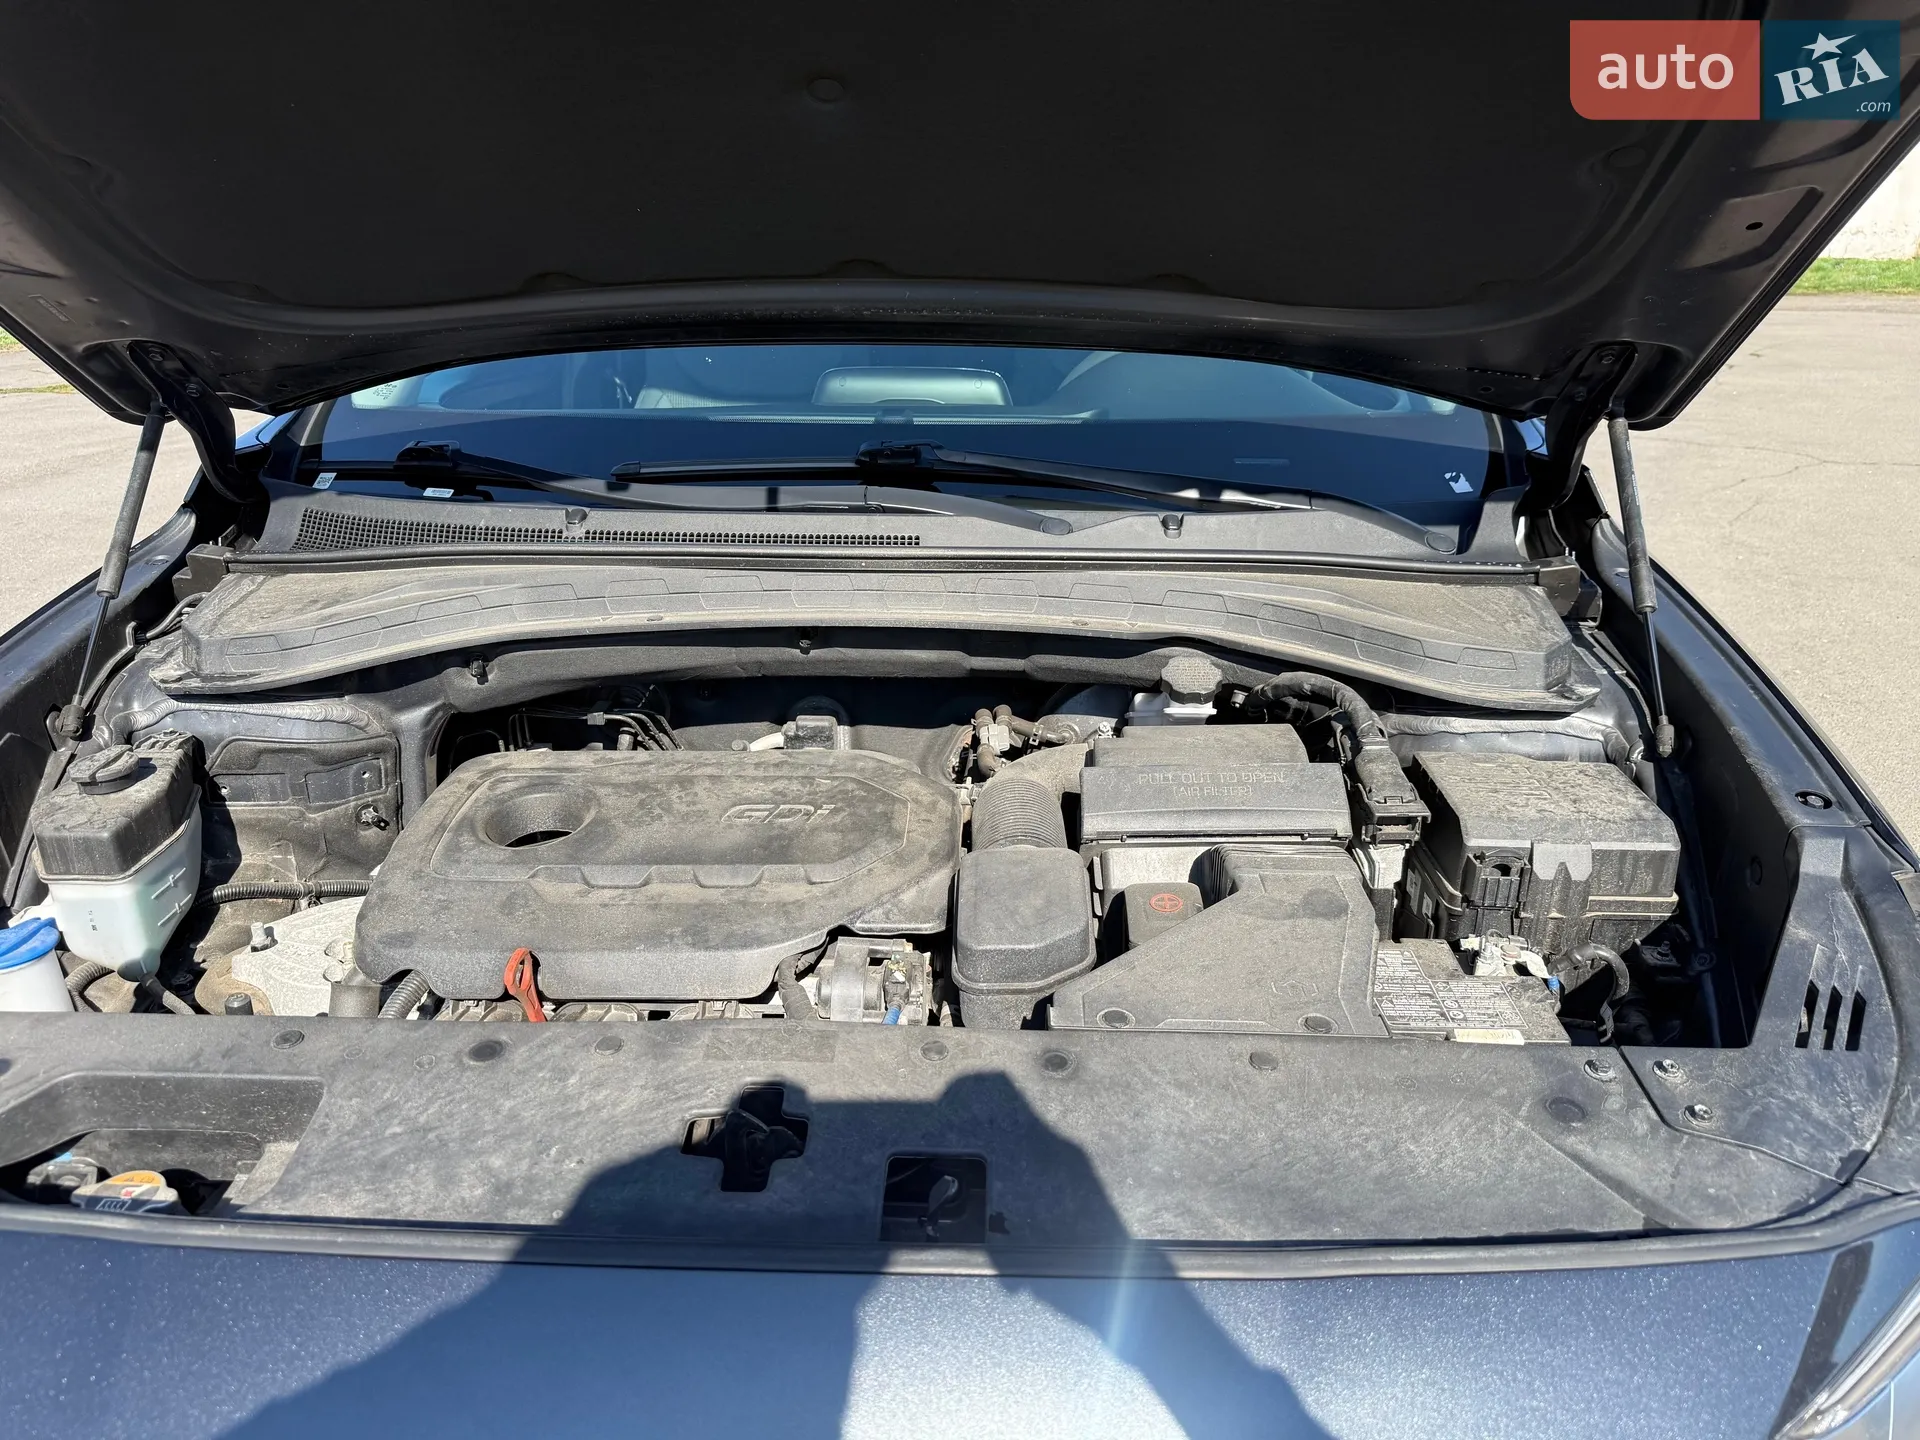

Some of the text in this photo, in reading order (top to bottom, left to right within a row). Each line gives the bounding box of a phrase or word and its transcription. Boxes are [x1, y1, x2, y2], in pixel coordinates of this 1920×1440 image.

[1138, 772, 1284, 785] PULL OUT TO OPEN
